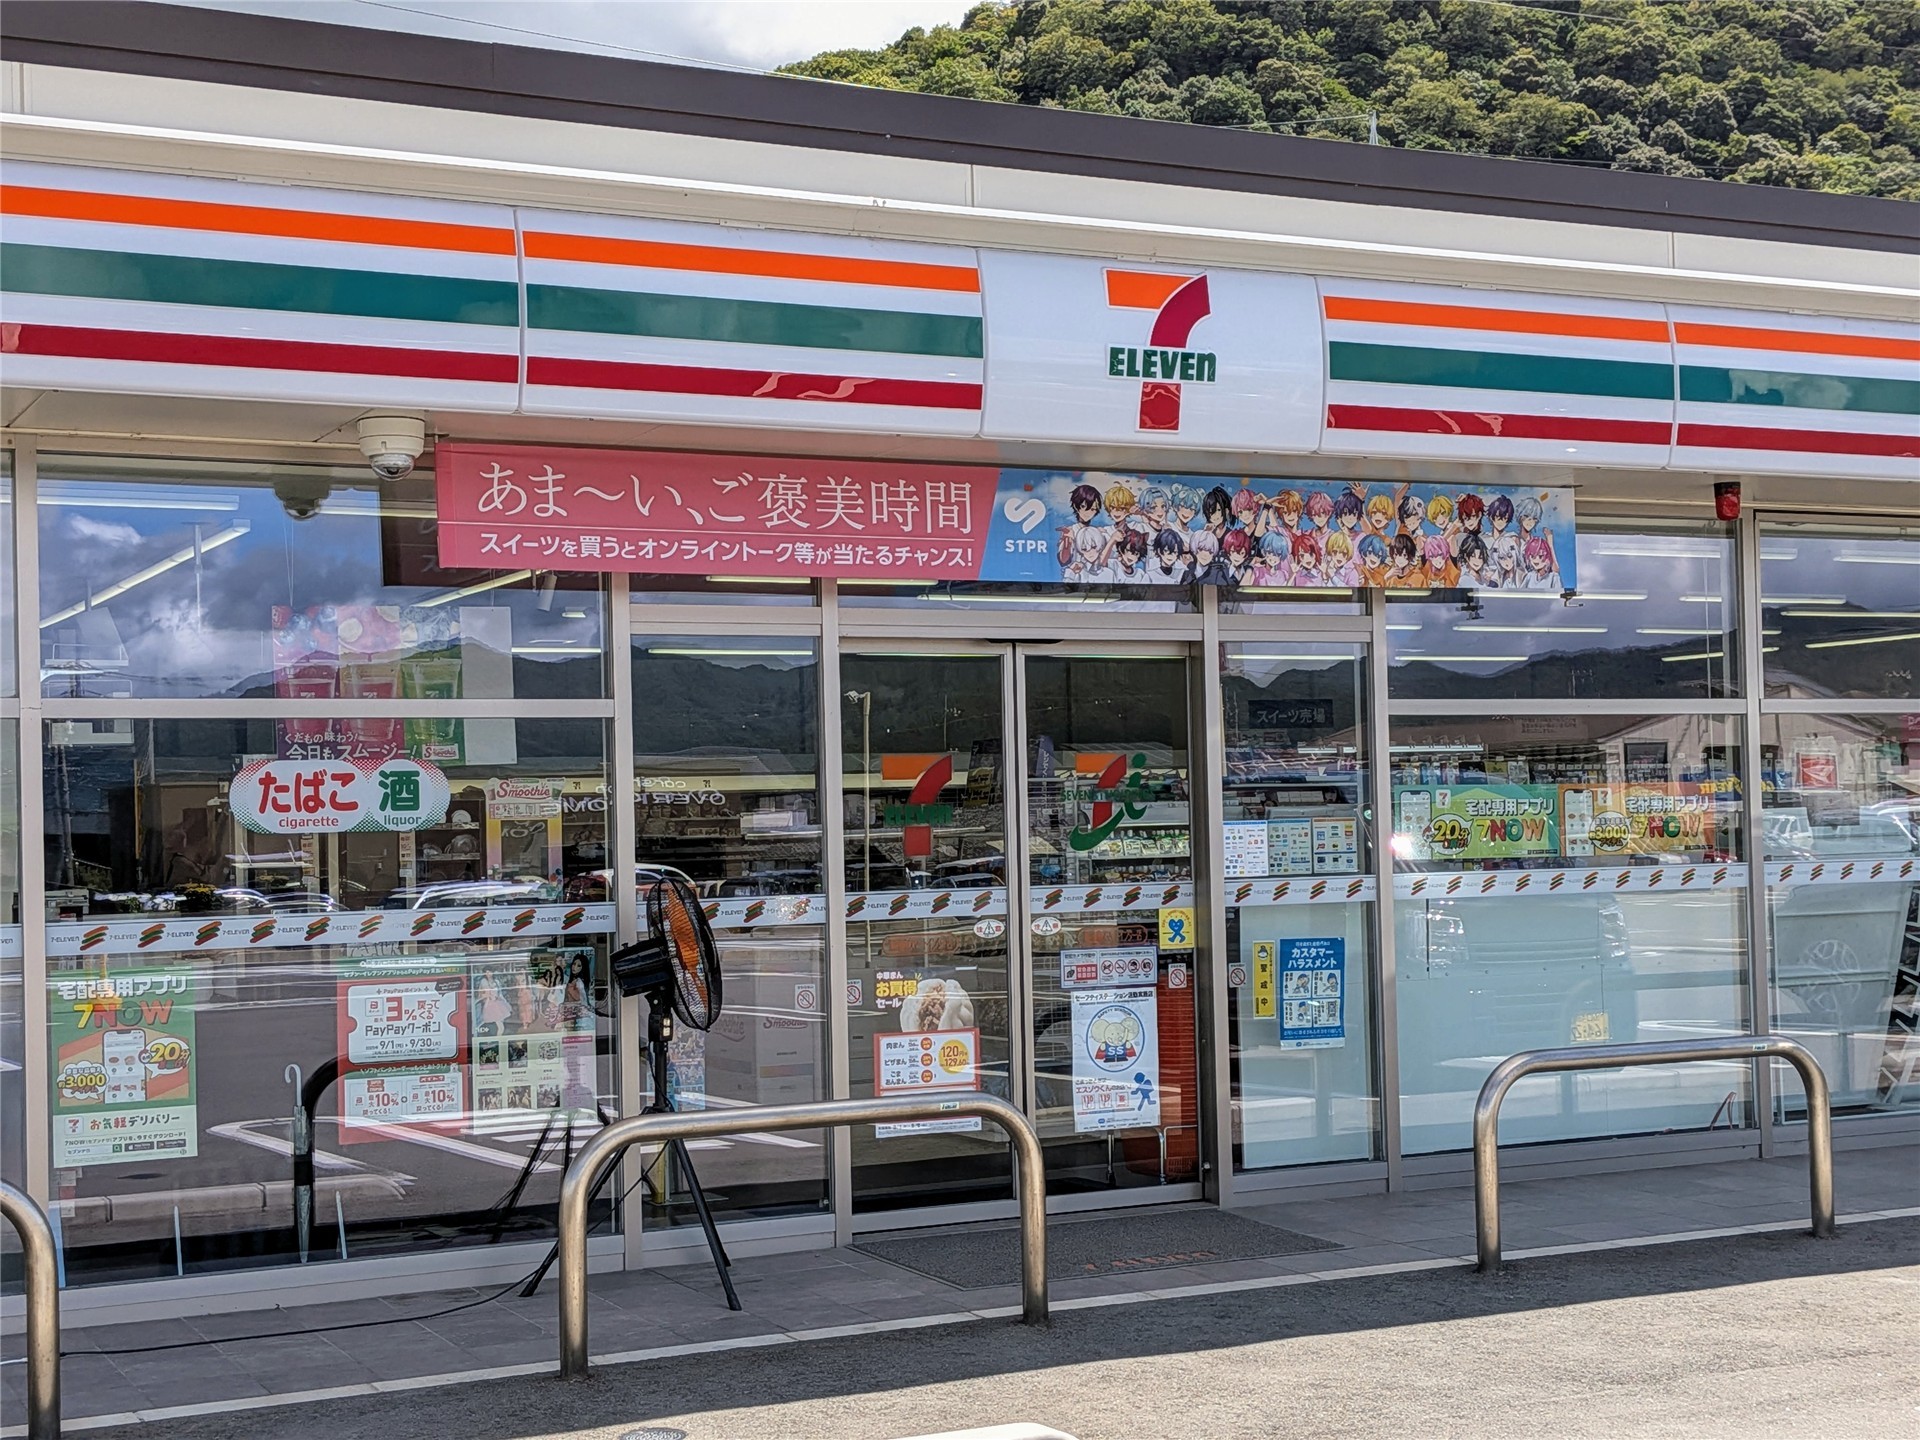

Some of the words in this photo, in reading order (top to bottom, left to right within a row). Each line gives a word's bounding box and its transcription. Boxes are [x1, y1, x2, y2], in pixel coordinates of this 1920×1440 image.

[1005, 539, 1048, 553] STPR
[1257, 708, 1325, 724] スイーツ売場
[284, 732, 359, 744] くだもの味わう!
[286, 743, 417, 760] 今日もスムージー!
[258, 768, 359, 814] たばこ
[378, 769, 421, 812] 酒
[497, 781, 550, 798] Smoothie
[1465, 797, 1554, 816] 宅配専用アプリ
[1625, 794, 1710, 813] 宅配専用アプリ
[278, 815, 339, 829] cigarette
[383, 814, 422, 827] liquor
[1632, 815, 1701, 838] 7NOW
[1476, 818, 1546, 842] 7NOW
[1291, 947, 1334, 958] カスタマー
[1288, 957, 1337, 969] ハラスメント
[876, 971, 904, 980] 中華まん
[57, 975, 187, 1000] 宅配専用アプリ
[876, 980, 917, 997] お買得
[417, 999, 441, 1010] 戻って
[876, 998, 902, 1008] セール
[73, 999, 174, 1029] 7NOW
[419, 1010, 434, 1020] くる
[365, 1021, 441, 1037] PayPayクーポン
[886, 1042, 905, 1050] 肉まん
[1108, 1046, 1124, 1056] SS
[884, 1058, 907, 1066] ピザまん
[90, 1113, 180, 1130] お気軽デリバリー
